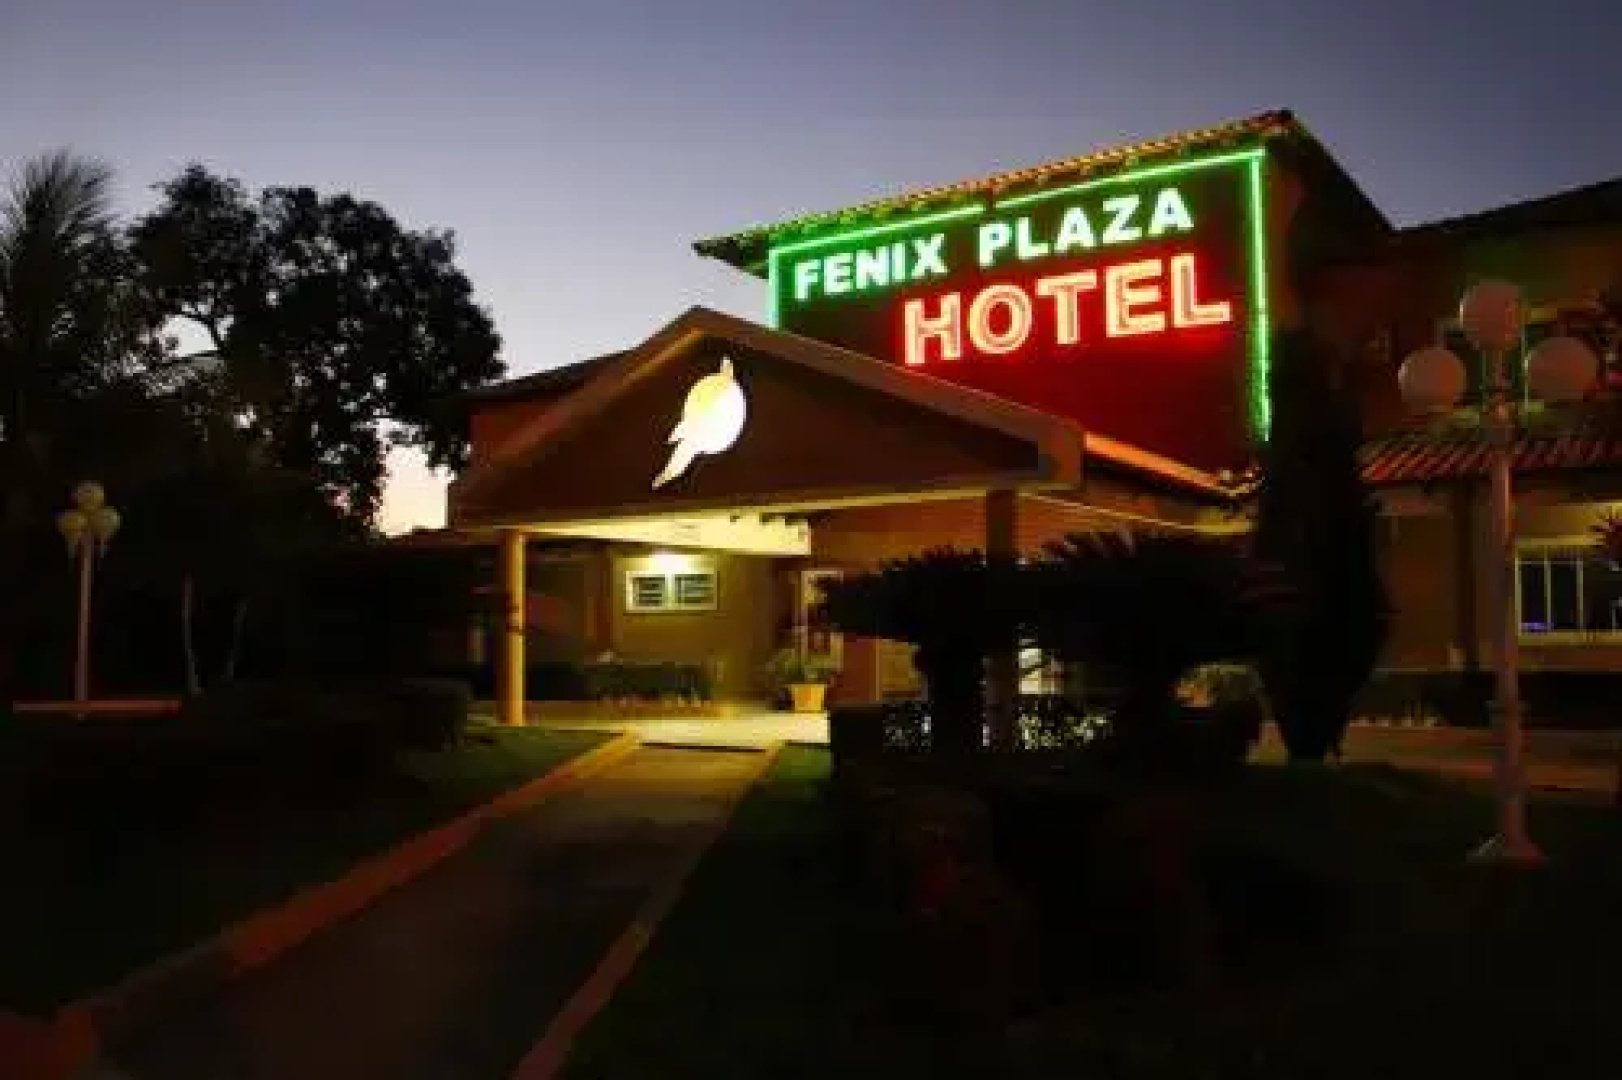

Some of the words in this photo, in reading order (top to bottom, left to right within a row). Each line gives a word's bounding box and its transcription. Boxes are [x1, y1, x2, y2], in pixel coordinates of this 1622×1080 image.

[795, 233, 947, 300] FENIX
[979, 187, 1194, 268] PLAZA
[904, 252, 1231, 366] HOTEL
